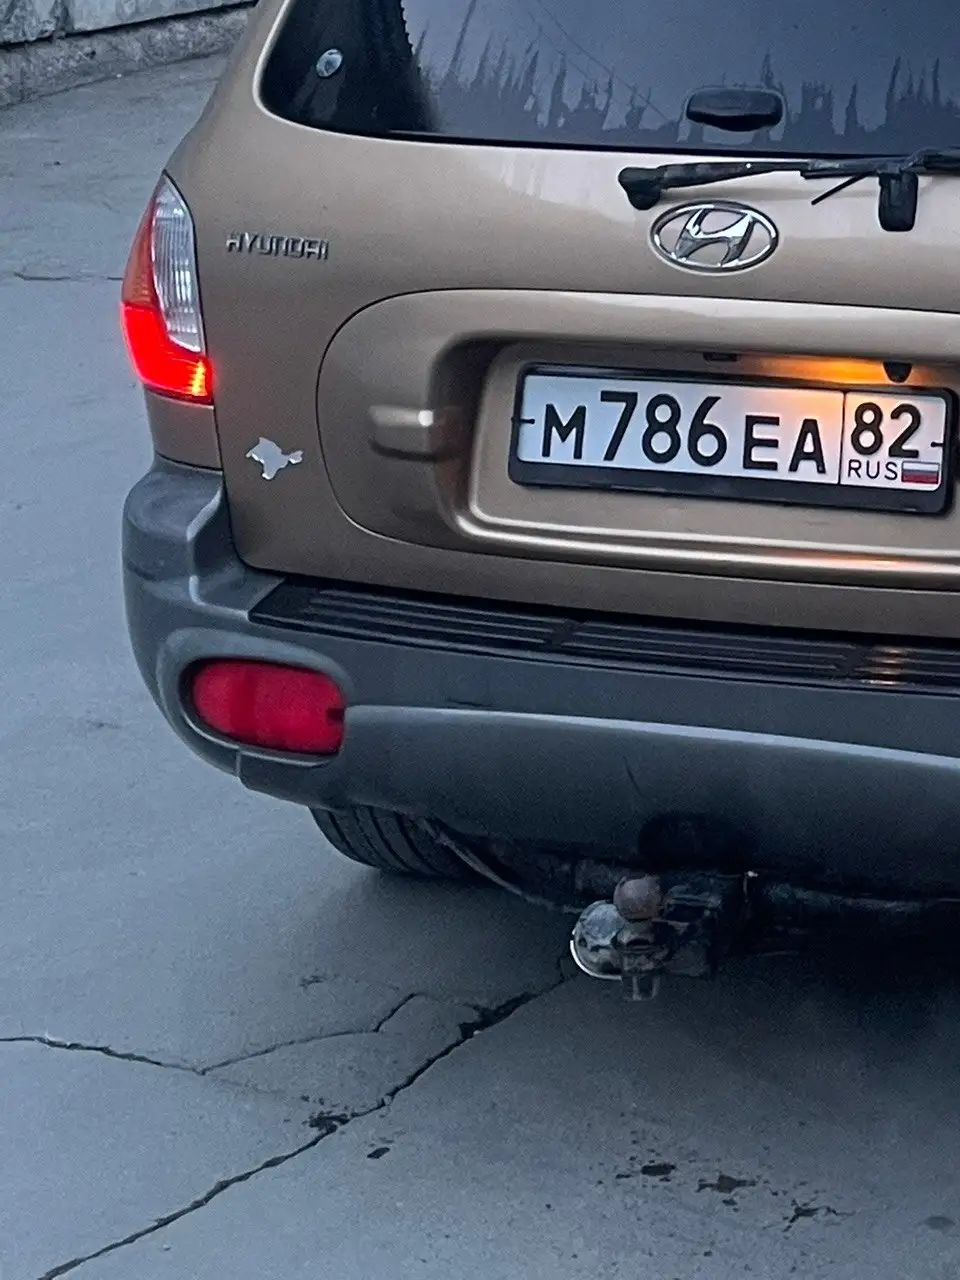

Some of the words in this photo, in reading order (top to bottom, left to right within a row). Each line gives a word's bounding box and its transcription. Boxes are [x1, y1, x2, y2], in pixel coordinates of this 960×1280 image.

[227, 232, 330, 260] HYUNDAI
[850, 402, 922, 458] 82
[848, 459, 898, 481] RUS
